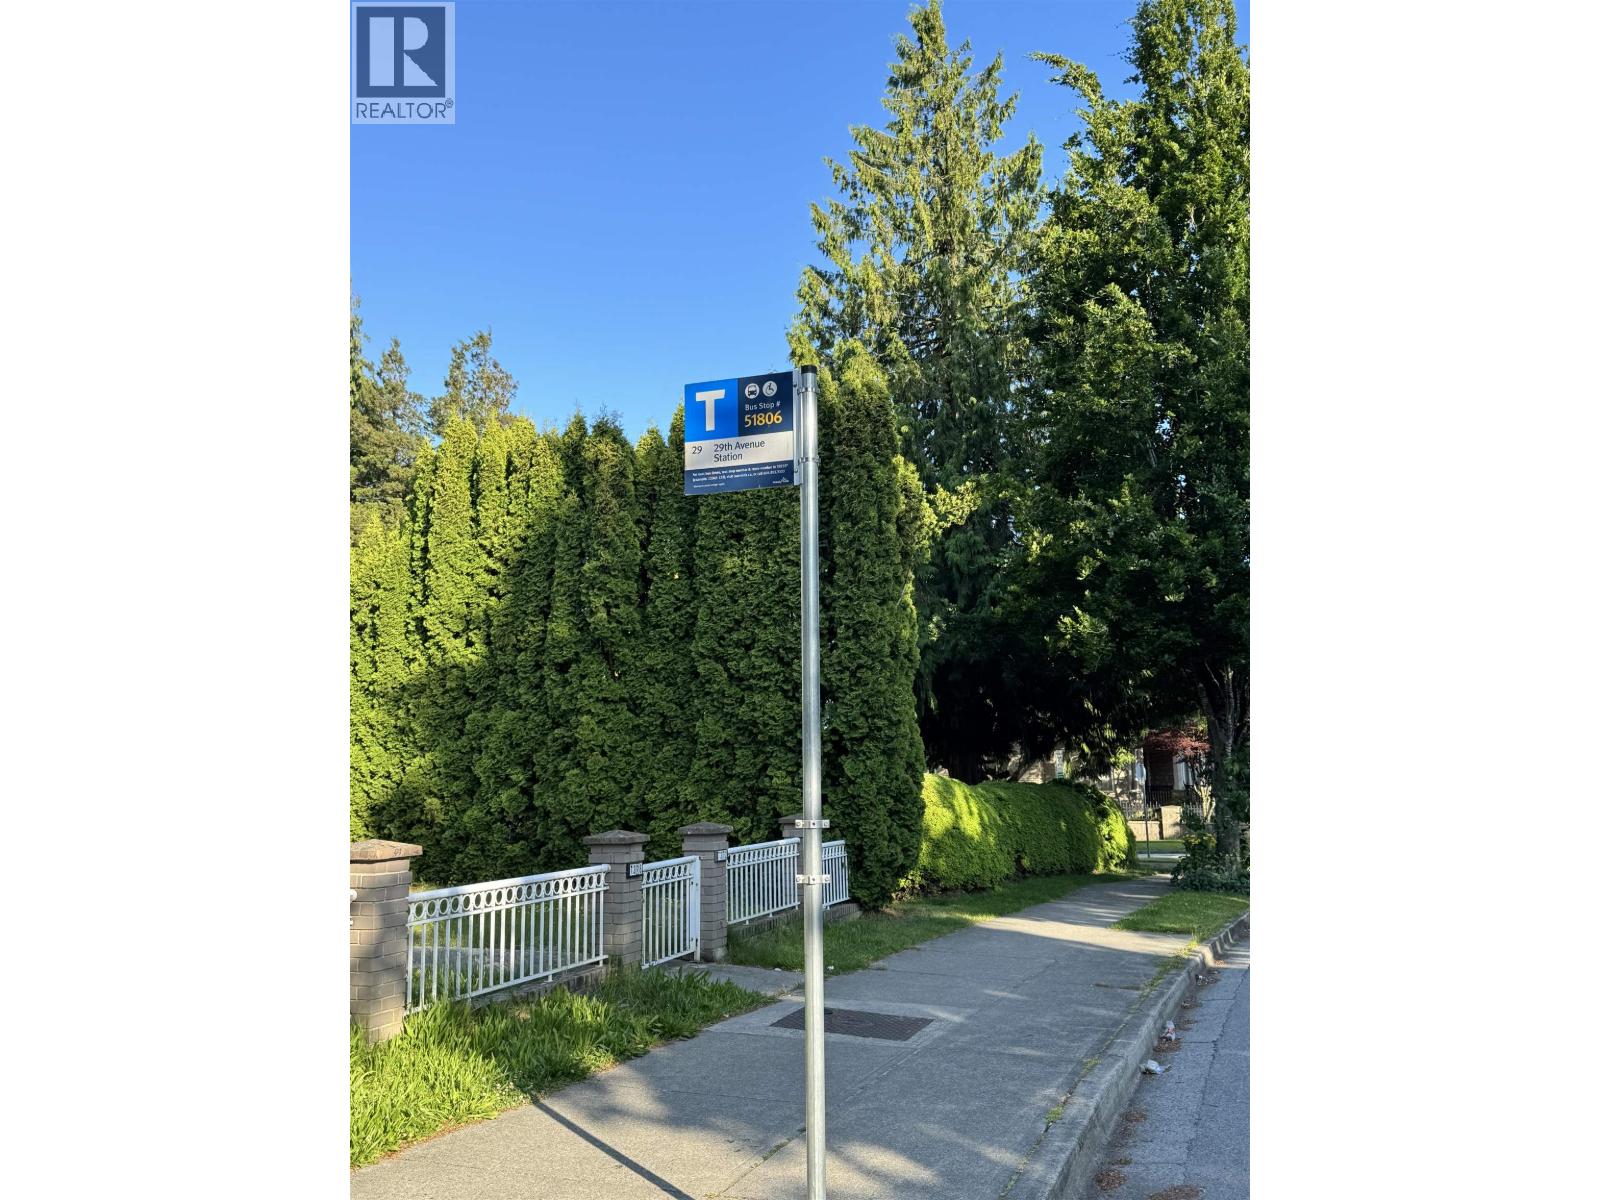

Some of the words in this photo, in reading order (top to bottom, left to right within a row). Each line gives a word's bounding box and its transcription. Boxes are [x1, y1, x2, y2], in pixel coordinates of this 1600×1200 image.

[695, 388, 726, 432] T
[744, 403, 758, 411] Bus
[759, 402, 775, 410] Stop
[744, 410, 783, 428] 51806
[691, 445, 703, 455] 29
[713, 441, 733, 453] 29th
[734, 440, 766, 450] Avenue
[713, 452, 743, 463] Station
